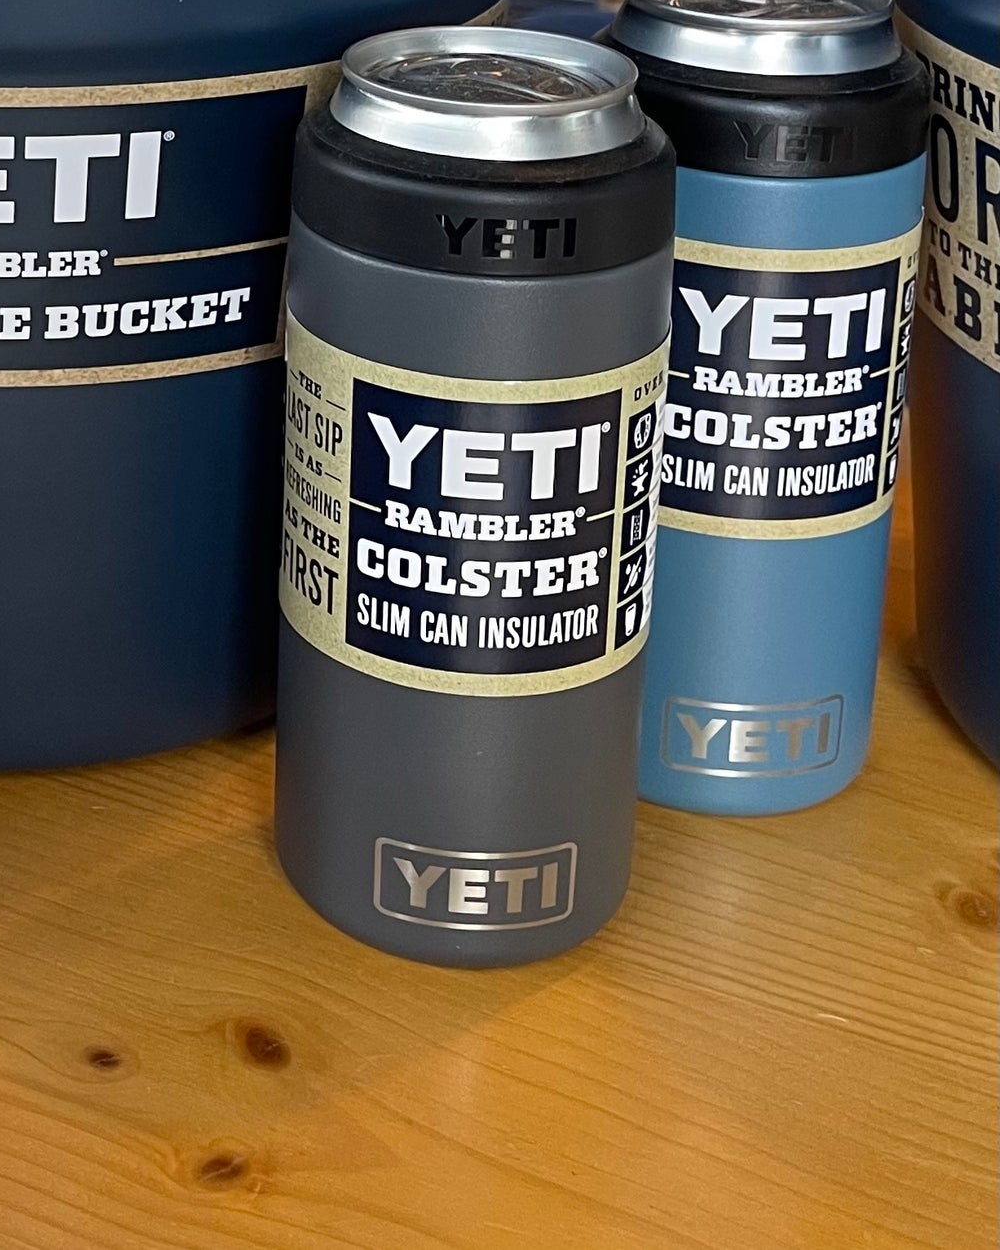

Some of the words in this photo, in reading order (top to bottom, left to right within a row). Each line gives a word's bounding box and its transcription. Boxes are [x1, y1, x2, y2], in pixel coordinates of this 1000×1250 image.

[916, 49, 1000, 133] RIN
[435, 213, 577, 259] YETI
[928, 218, 951, 257] TO
[44, 287, 251, 341] BUCKET
[679, 286, 887, 361] YETI
[299, 370, 322, 400] THE
[287, 384, 311, 440] LAST
[314, 412, 343, 457] SIP
[294, 442, 305, 463] IS
[306, 455, 323, 477] AS
[661, 454, 716, 491] SLIM
[724, 465, 769, 497] CAN
[777, 454, 875, 498] INSULATOR
[285, 498, 299, 528] AS
[301, 515, 340, 559] THE
[284, 528, 339, 616] FIRST
[357, 593, 410, 638] SLIM
[420, 610, 468, 648] CAN
[478, 604, 599, 650] INSULATOR
[677, 712, 832, 763] YETI
[393, 857, 560, 915] YETI
